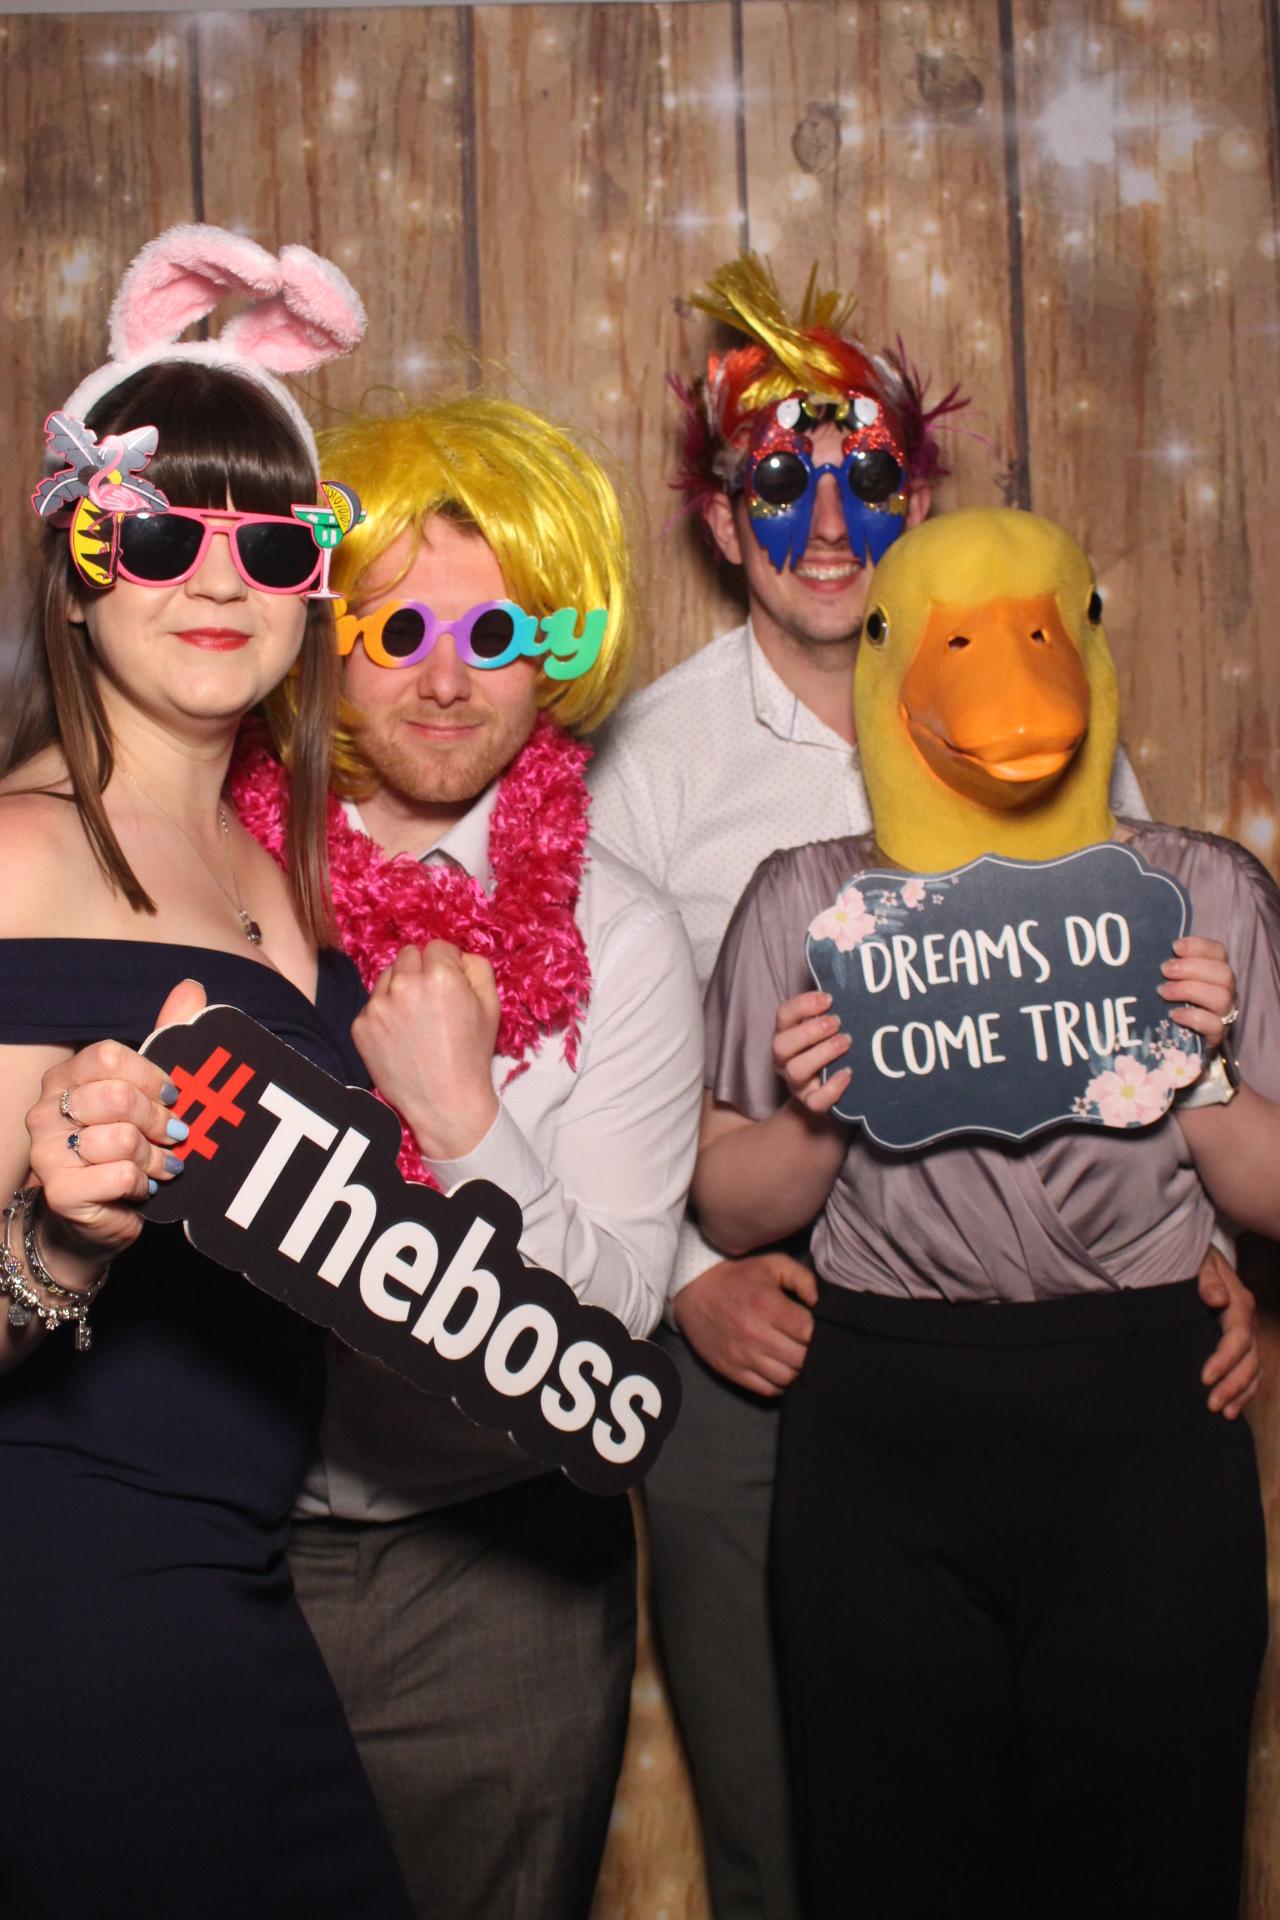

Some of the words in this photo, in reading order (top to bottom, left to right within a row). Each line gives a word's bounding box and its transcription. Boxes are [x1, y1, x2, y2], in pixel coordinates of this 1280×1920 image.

[333, 598, 608, 680] roovy
[860, 920, 1050, 1000] DREAMS
[1065, 912, 1130, 967] DO
[871, 1013, 1006, 1078] COME
[1020, 996, 1142, 1067] TRUE
[168, 1046, 662, 1464] #Theboss
